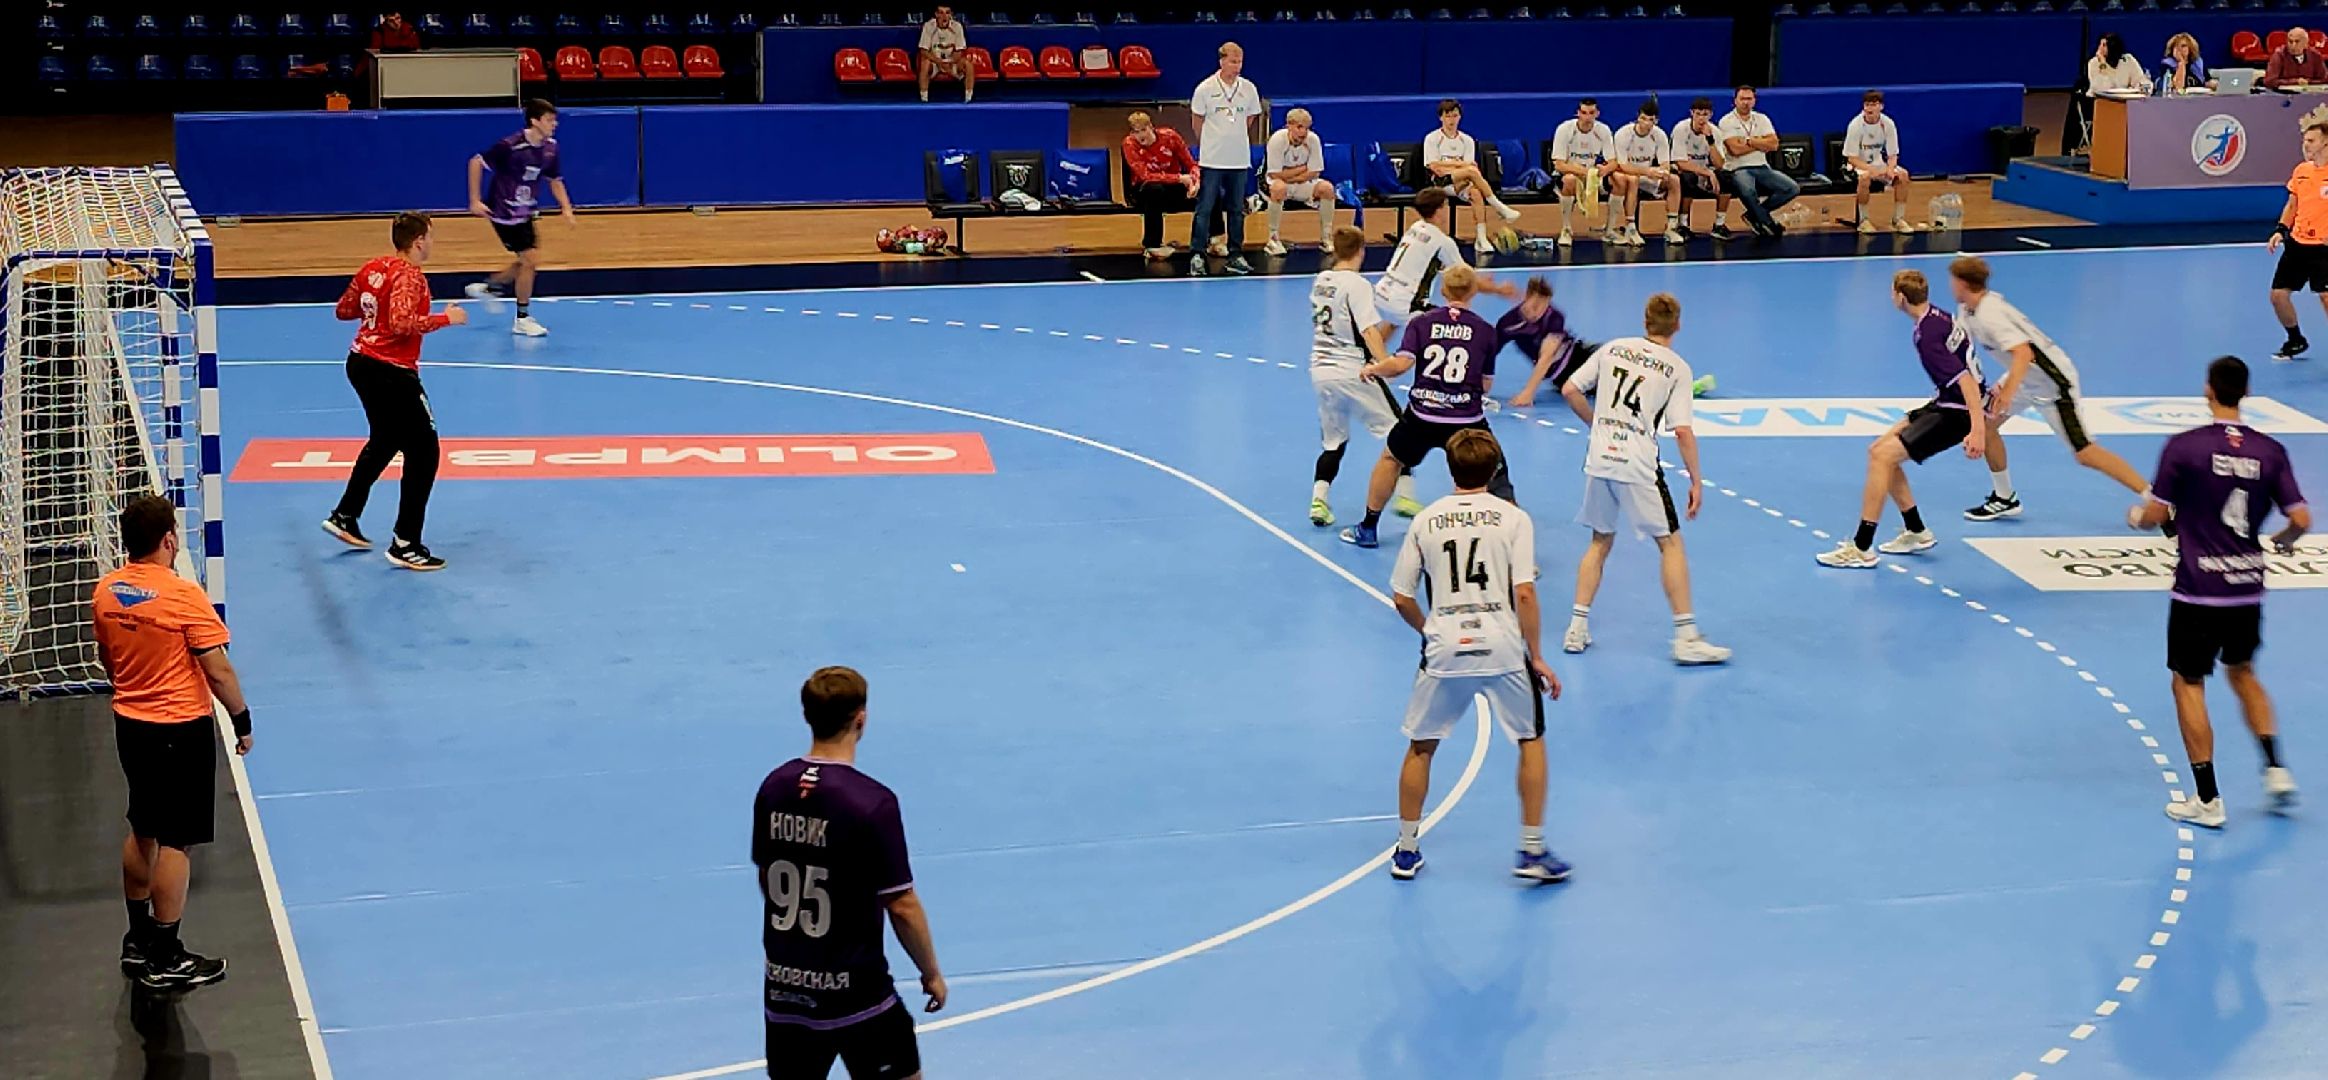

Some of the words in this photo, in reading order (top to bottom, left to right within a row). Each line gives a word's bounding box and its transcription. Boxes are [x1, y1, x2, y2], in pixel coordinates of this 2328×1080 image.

[1423, 344, 1470, 384] 28
[1611, 365, 1643, 418] 74
[271, 446, 958, 468] OLIMPBT
[1429, 510, 1502, 534] ГОНЧАРОВ
[2220, 487, 2250, 539] 4
[1443, 537, 1489, 593] 14
[770, 810, 830, 847] НОВИК
[767, 859, 832, 938] 95
